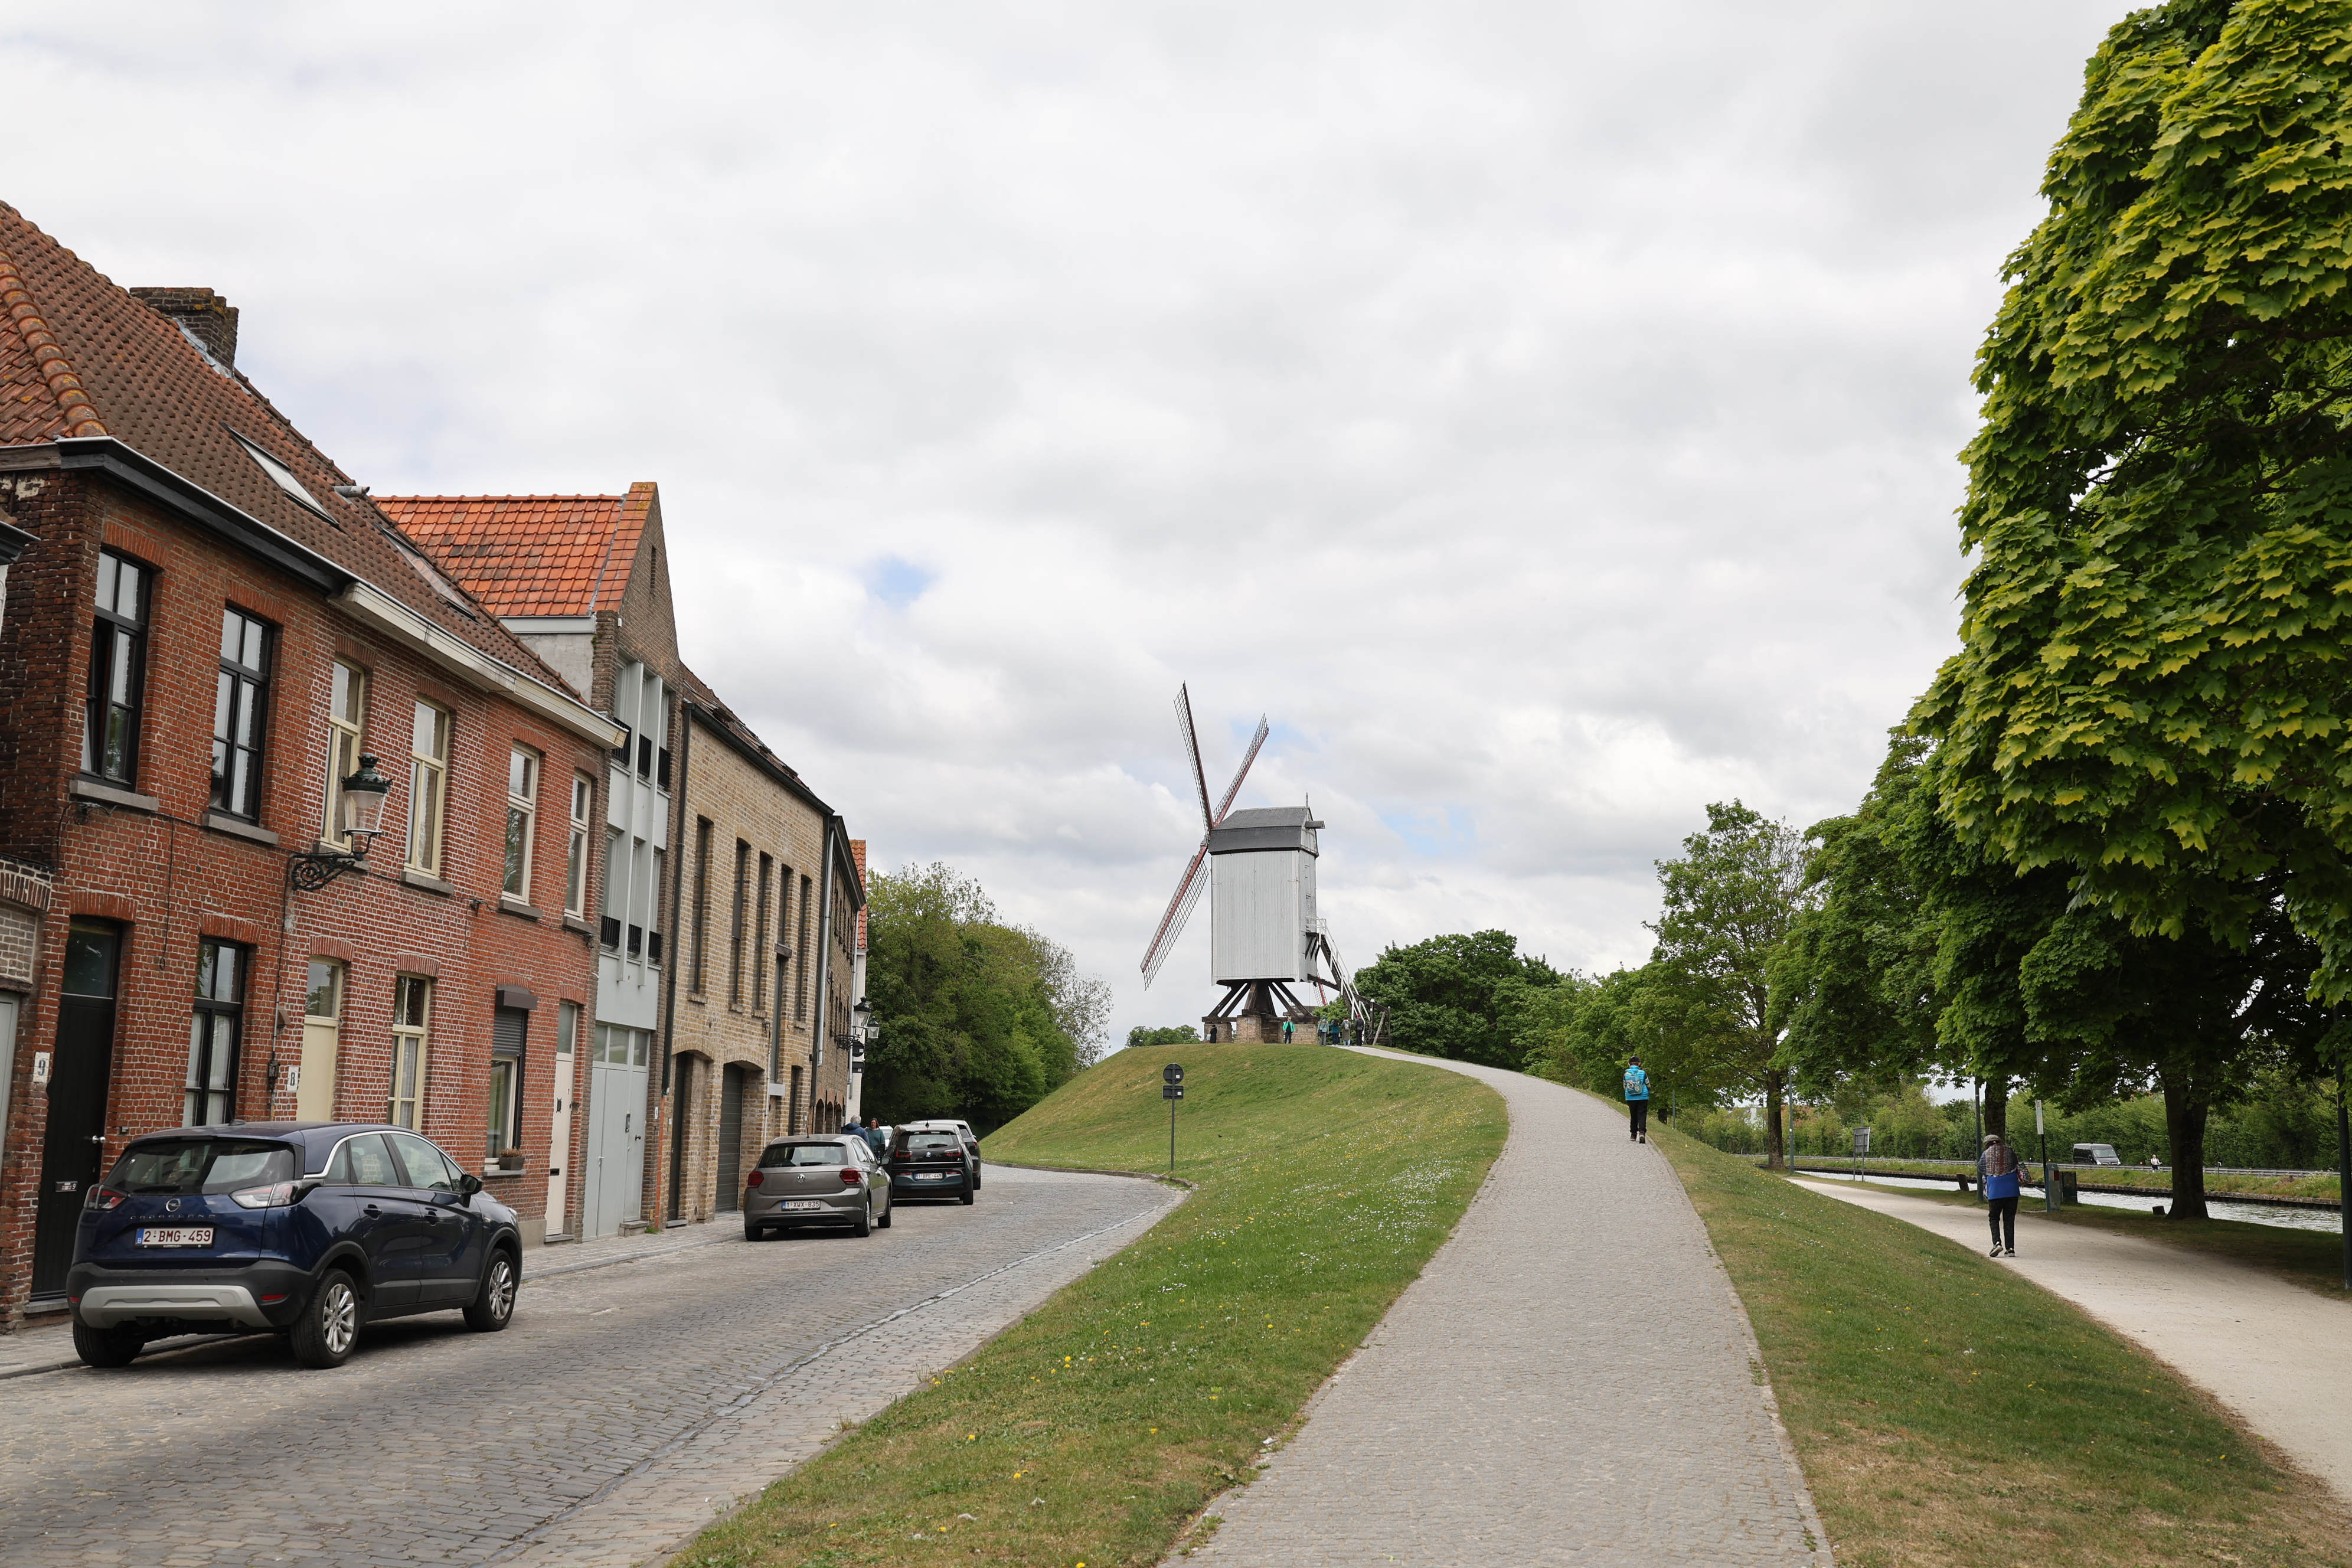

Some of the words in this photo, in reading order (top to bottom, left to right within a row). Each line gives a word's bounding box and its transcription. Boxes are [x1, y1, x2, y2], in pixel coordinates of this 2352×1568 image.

[38, 1059, 46, 1076] 9
[290, 1072, 295, 1086] 8
[143, 1230, 211, 1242] 2-BMG-459
